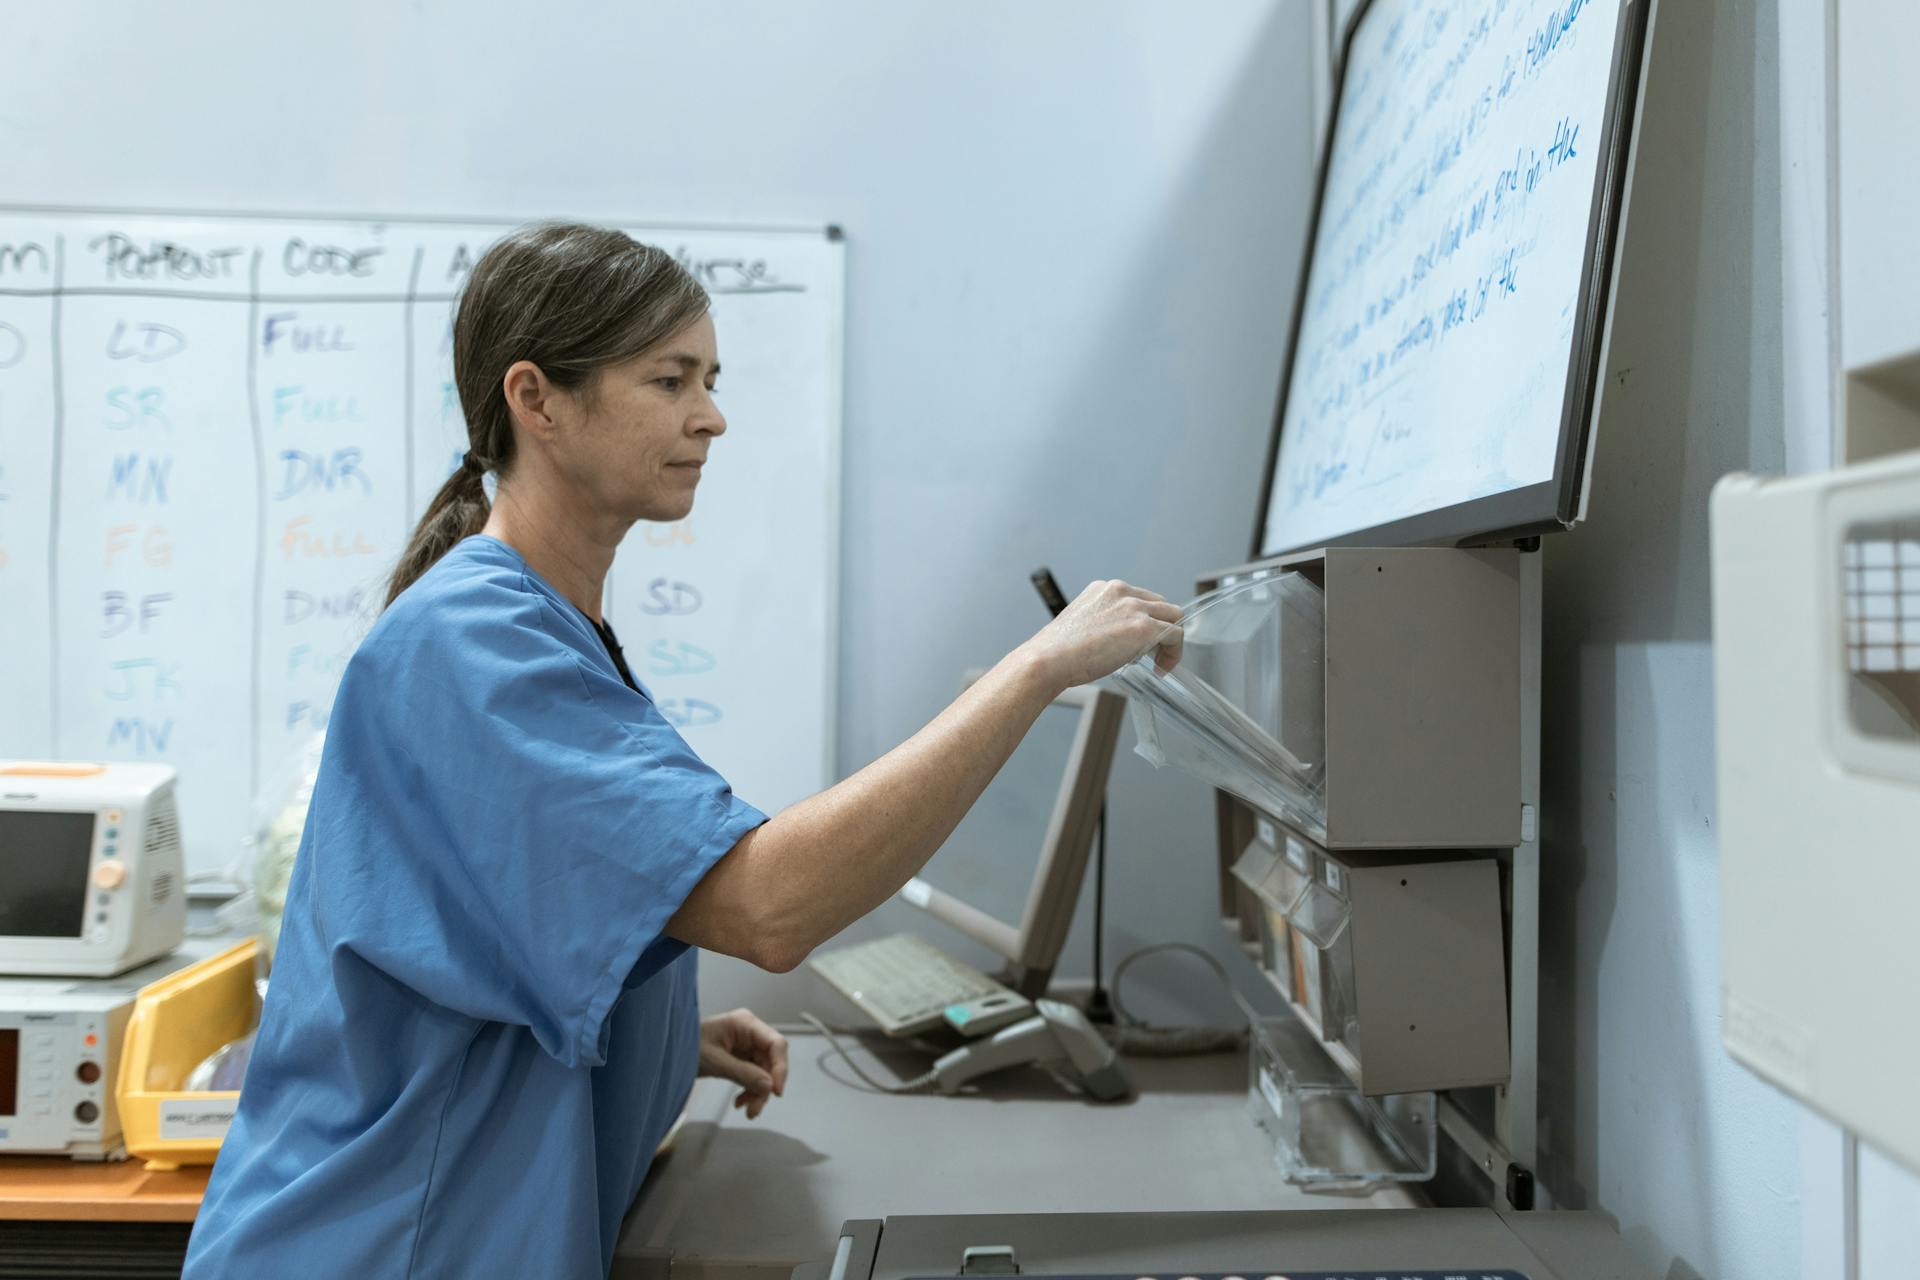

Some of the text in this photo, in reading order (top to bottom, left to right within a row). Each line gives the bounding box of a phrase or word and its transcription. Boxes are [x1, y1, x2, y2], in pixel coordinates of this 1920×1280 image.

[1525, 151, 1544, 193] in
[1548, 116, 1579, 172] the
[282, 237, 386, 277] CODE
[676, 244, 780, 288] urse
[1499, 248, 1519, 300] the
[106, 320, 189, 363] LD
[105, 386, 172, 430] SR
[272, 446, 374, 501] DNR
[104, 525, 174, 568] FG
[99, 589, 175, 638] BF
[640, 577, 703, 616] SD
[648, 639, 718, 677] SD
